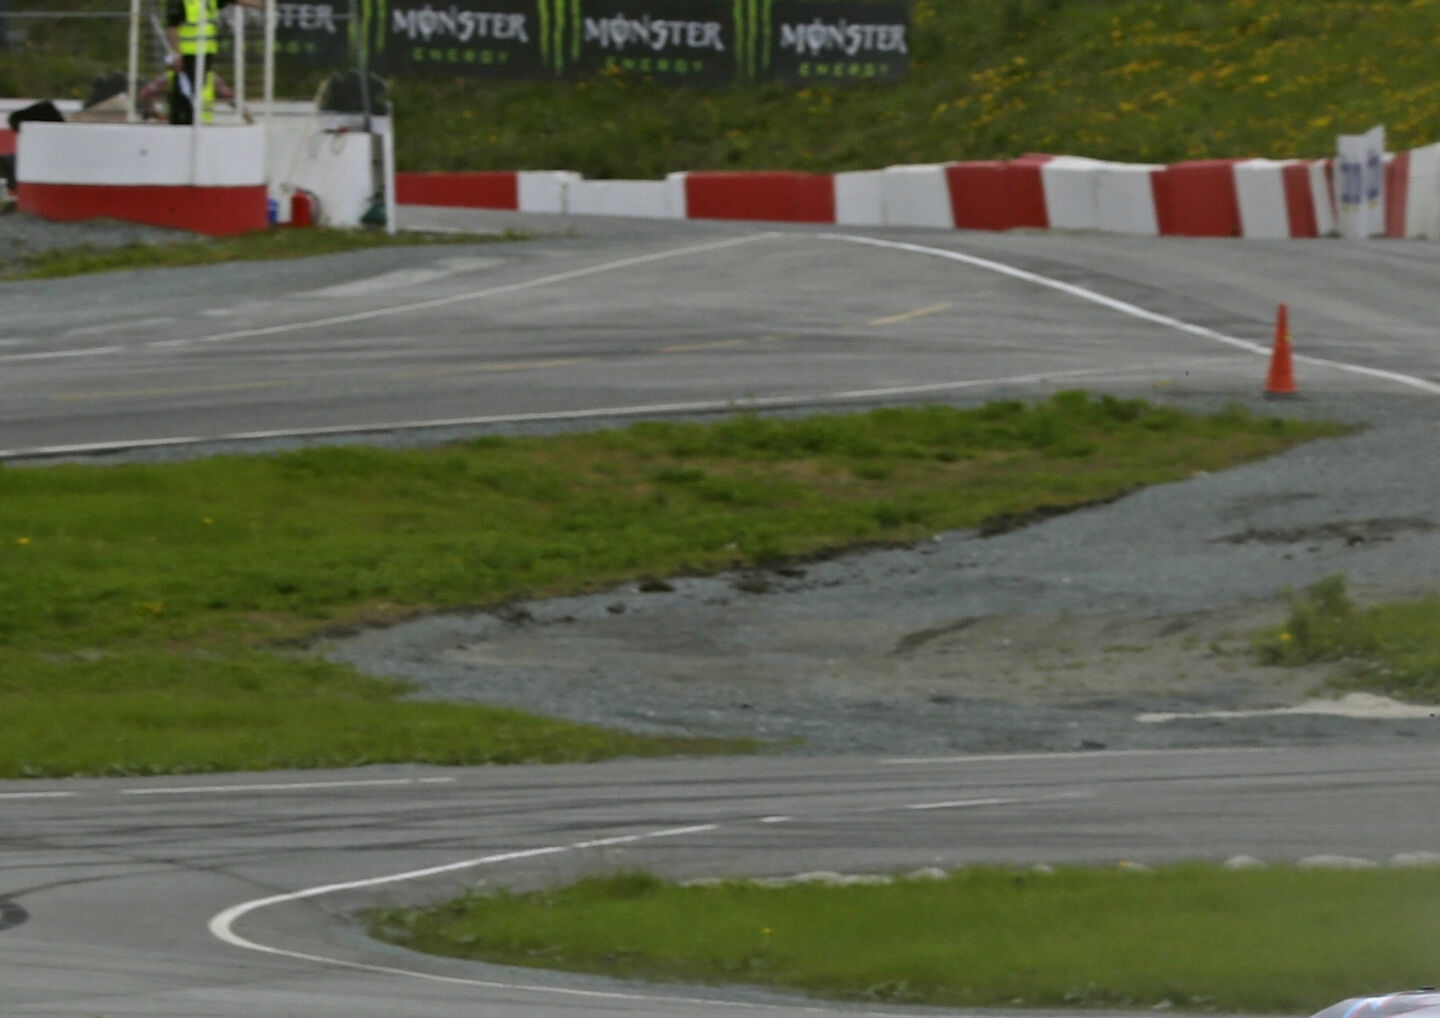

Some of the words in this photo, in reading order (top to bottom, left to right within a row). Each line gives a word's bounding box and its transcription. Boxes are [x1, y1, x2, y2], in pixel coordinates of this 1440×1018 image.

[392, 5, 529, 43] MONSTER
[584, 12, 725, 51] MONSTER
[781, 18, 907, 56] MONSTER
